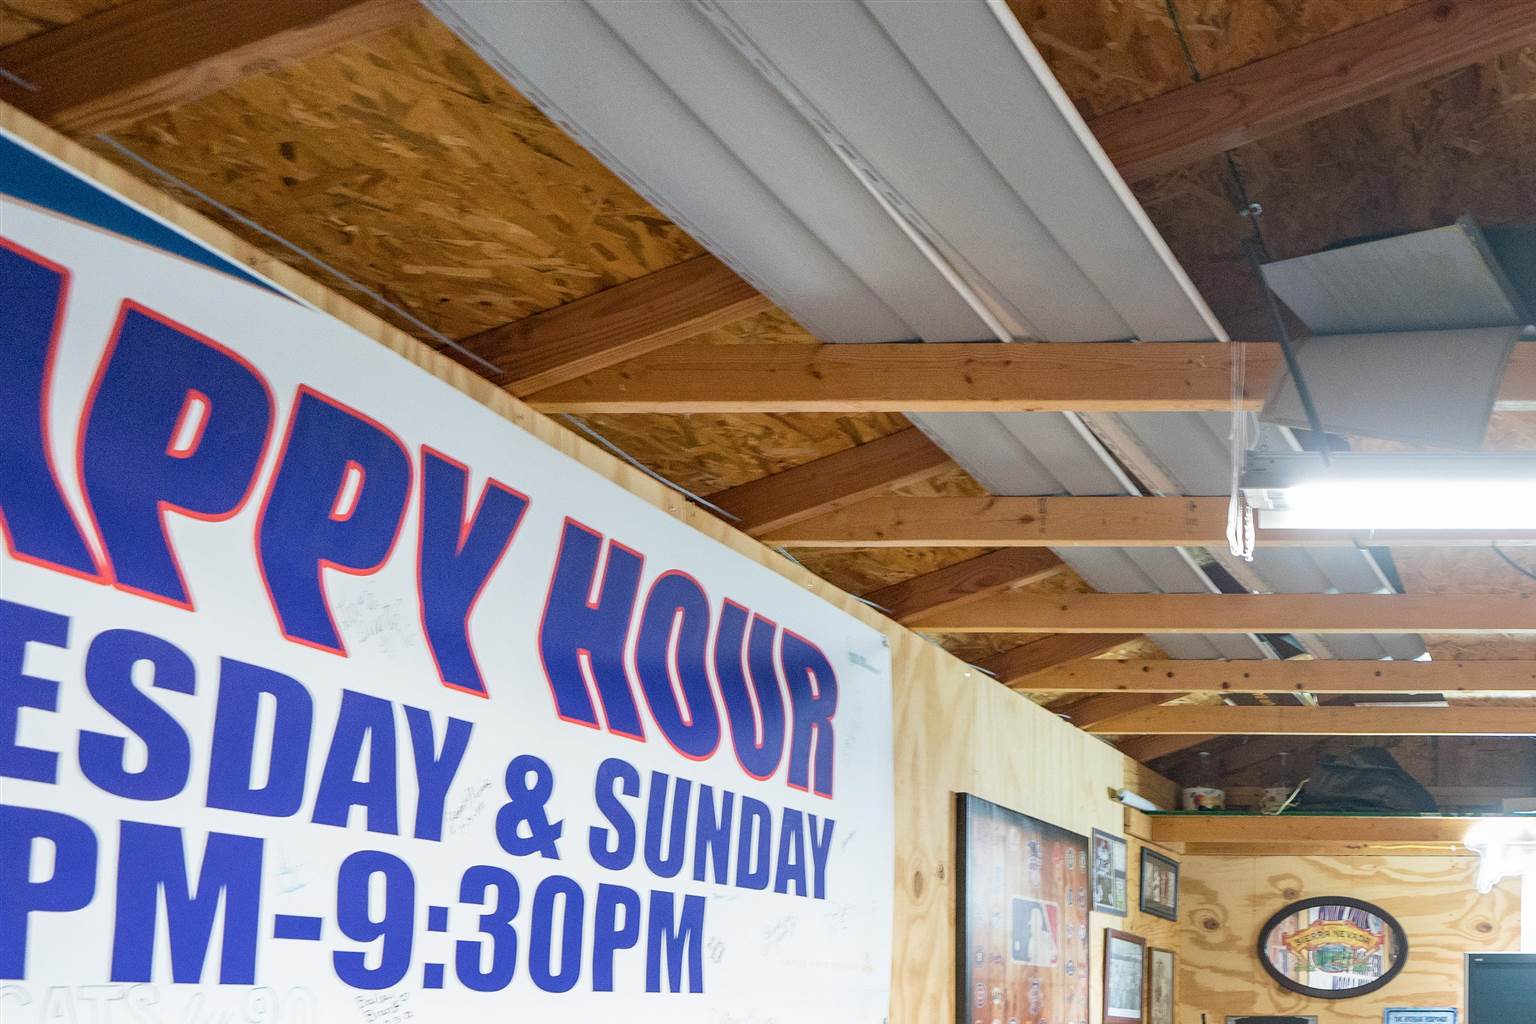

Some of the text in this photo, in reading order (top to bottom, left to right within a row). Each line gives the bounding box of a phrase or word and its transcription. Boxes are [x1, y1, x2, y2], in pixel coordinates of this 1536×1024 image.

[0, 599, 474, 842] ESDAY
[495, 754, 564, 859] &
[588, 757, 835, 900] SUNDAY
[538, 516, 840, 799] HOUR
